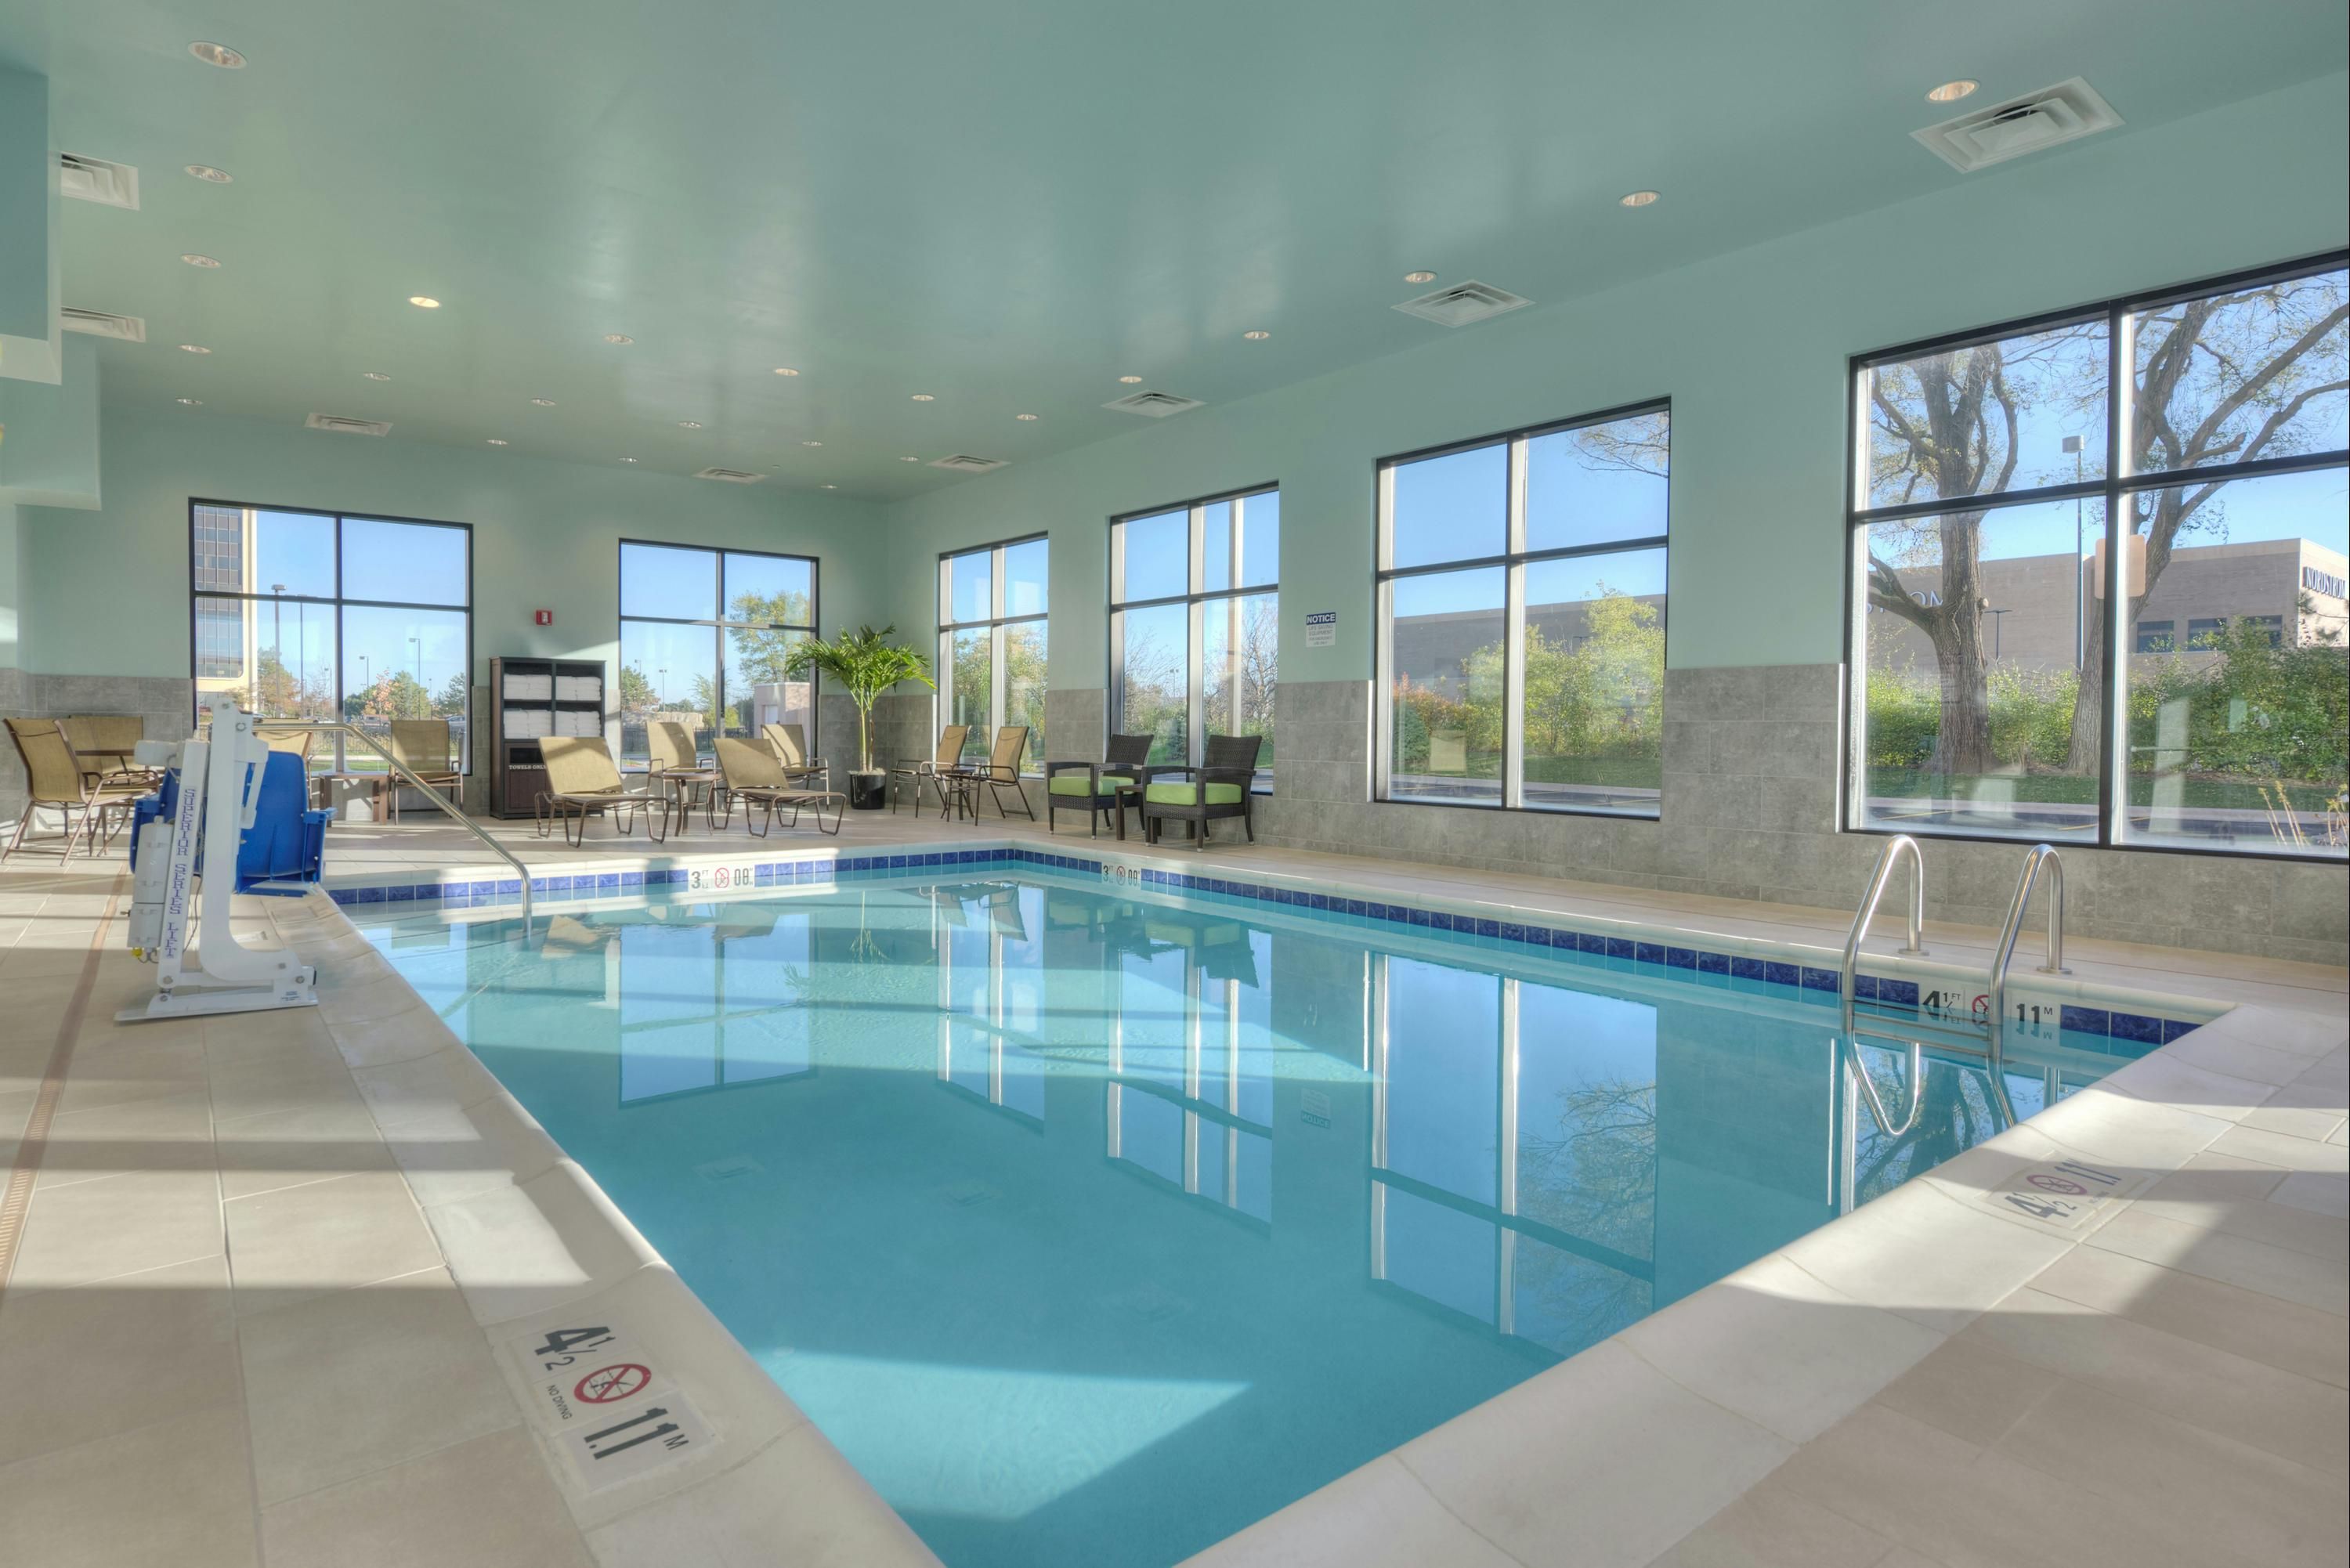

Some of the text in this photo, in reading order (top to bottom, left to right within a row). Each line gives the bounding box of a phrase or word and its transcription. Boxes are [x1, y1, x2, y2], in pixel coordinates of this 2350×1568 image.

[2303, 566, 2345, 600] NORDSTROM
[1307, 613, 1336, 624] NOTICE
[165, 789, 196, 958] SUPERIOR SERIES LIFT
[2044, 1007, 2053, 1016] M
[546, 1384, 573, 1420] NO DIVING
[663, 1433, 689, 1451] M
